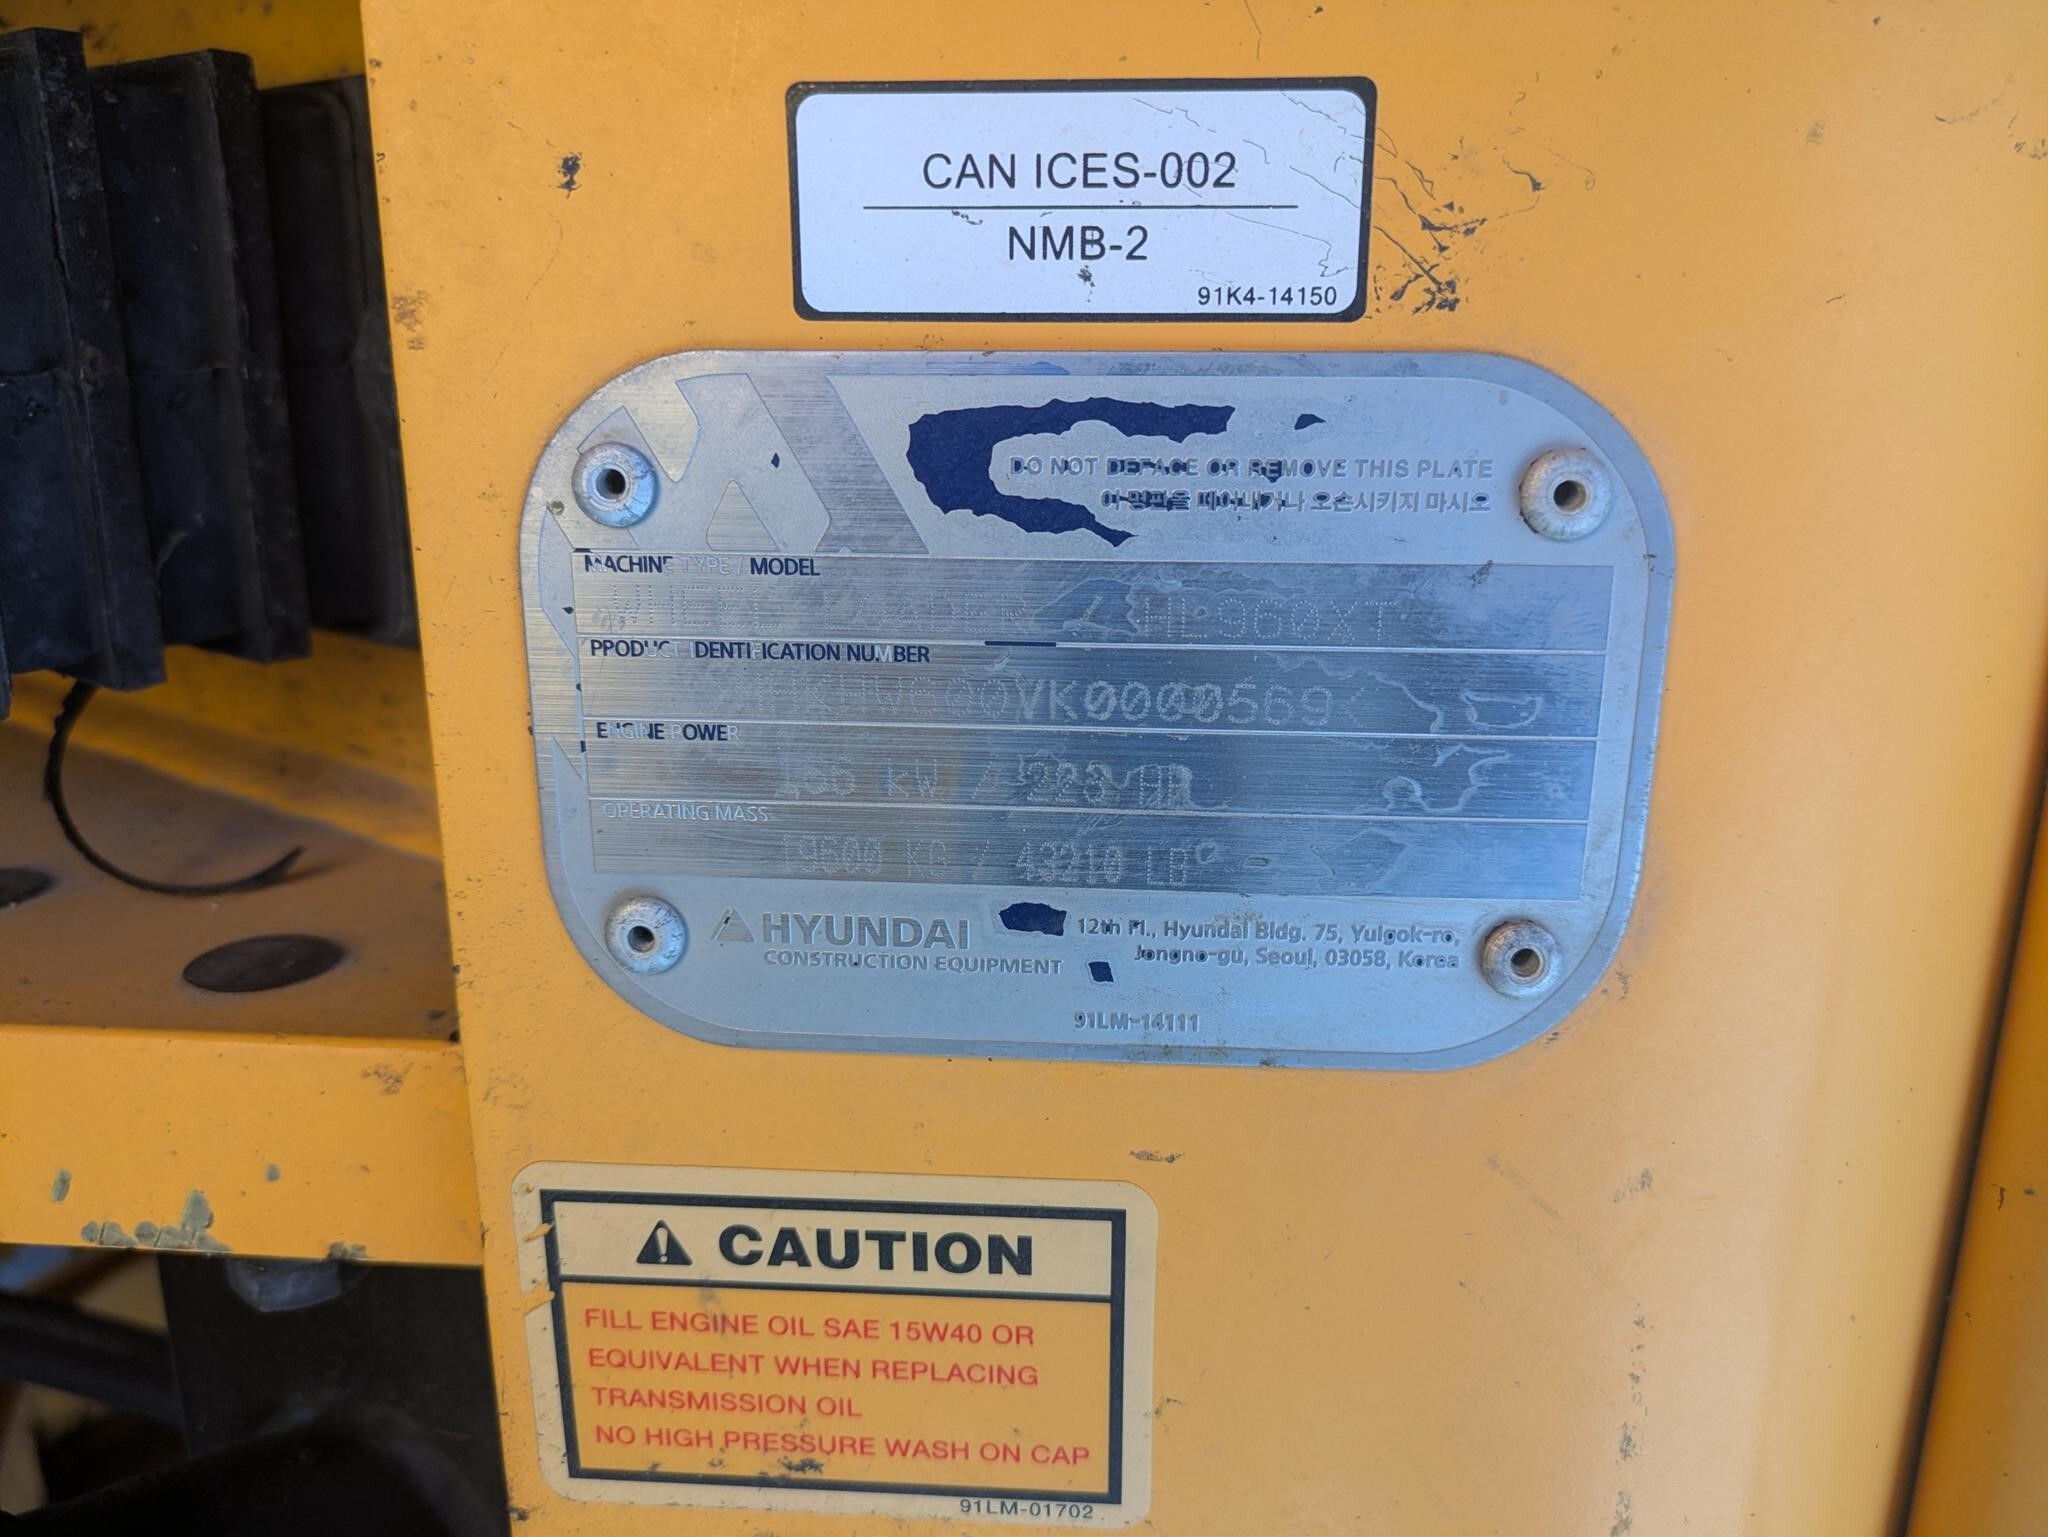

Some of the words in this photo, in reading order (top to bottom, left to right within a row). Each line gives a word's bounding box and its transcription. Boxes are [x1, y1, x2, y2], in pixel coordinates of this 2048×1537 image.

[922, 152, 1016, 190] CAN
[1035, 151, 1237, 190] ICES-002
[1007, 225, 1150, 262] NMB-2
[1197, 285, 1338, 307] 91K4-14150
[1010, 457, 1044, 477] DO
[1050, 457, 1099, 477] NOT
[1106, 457, 1199, 477] DEFACE
[1206, 458, 1240, 477] OR
[1248, 458, 1347, 479] REMOVE
[1354, 459, 1410, 479] THIS
[1416, 459, 1494, 479] PLATE
[1310, 490, 1420, 514] 오손시키지
[1424, 491, 1491, 514] 마시오
[584, 555, 674, 574] MACHINE
[681, 556, 730, 575] TYPE
[749, 557, 821, 577] MODEL
[612, 584, 781, 631] WHEEL
[1143, 596, 1400, 642] HL960XT
[589, 639, 682, 659] PRODUCT
[690, 641, 841, 662] IDENTIFICATION
[846, 643, 931, 663] NUMBER
[596, 722, 666, 740] ENGINE
[671, 724, 741, 743] POWER
[603, 803, 710, 821] OPERATING
[715, 805, 770, 823] MASS
[761, 911, 971, 950] HYUNDAI
[1077, 917, 1121, 937] 12th
[1163, 919, 1250, 944] Hyundai
[1255, 920, 1307, 944] Bldg.
[1314, 922, 1344, 945] 75,
[1350, 923, 1461, 948] Yulgok-ro,
[762, 949, 929, 972] CONSTRUCTION
[935, 954, 1063, 976] EQUIPMENT
[1134, 944, 1249, 969] Jongno-gu,
[1255, 946, 1317, 970] Seoul,
[1324, 948, 1392, 971] 03058,
[1398, 949, 1460, 970] Korea
[1073, 1010, 1199, 1034] 91LM-14111
[718, 1223, 1033, 1276] CAUTION
[584, 1307, 643, 1332] FILL
[651, 1310, 760, 1336] ENGINE
[767, 1314, 815, 1338] OIL
[823, 1317, 880, 1341] SAE
[889, 1320, 983, 1345] 15W40
[991, 1323, 1035, 1347] OR
[588, 1348, 765, 1376] EQUIVALENT
[773, 1355, 861, 1380] WHEN
[871, 1360, 1039, 1387] REPLACING
[591, 1386, 808, 1416] TRANSMISSION
[816, 1393, 863, 1418] OIL
[595, 1425, 637, 1446] NO
[645, 1426, 715, 1450] HIGH
[723, 1429, 875, 1457] PRESSURE
[884, 1437, 971, 1462] WASH
[978, 1441, 1021, 1465] ON
[1031, 1444, 1091, 1468] CAP
[959, 1498, 1095, 1520] 91LM-01702
